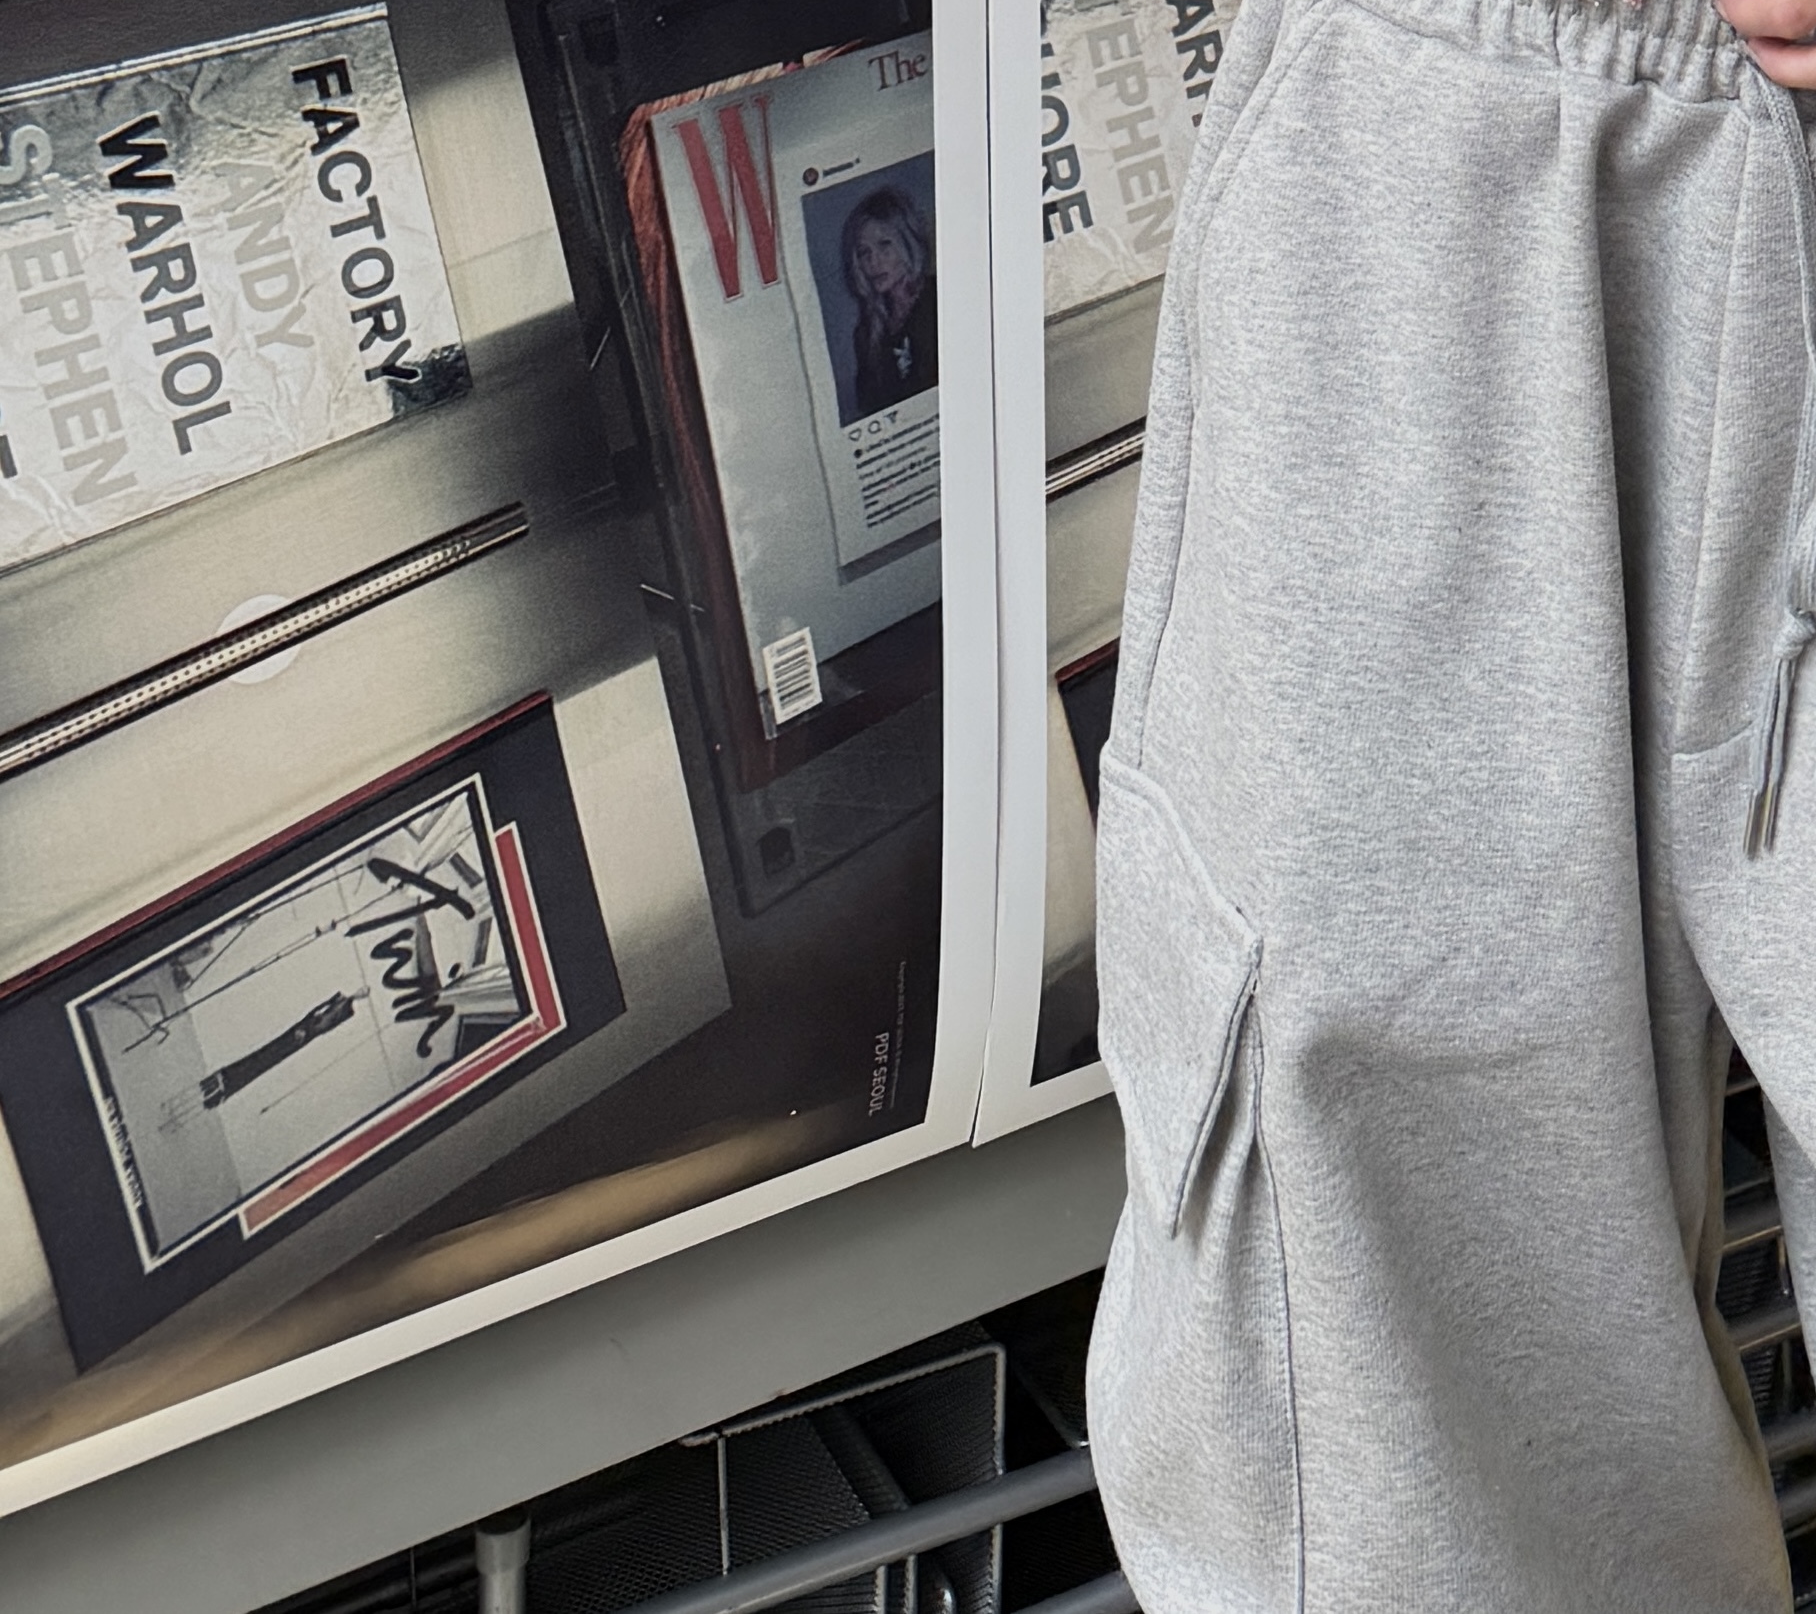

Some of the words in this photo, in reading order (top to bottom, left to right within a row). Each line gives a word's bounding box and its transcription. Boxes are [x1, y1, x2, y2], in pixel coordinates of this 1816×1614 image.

[868, 49, 929, 92] The
[98, 109, 233, 456] WARHOL
[209, 160, 316, 352] ANDY
[292, 53, 424, 385] FACTORY
[670, 92, 781, 304] W
[0, 123, 139, 507] STEPHEN
[344, 855, 478, 1060] Twin
[874, 1032, 890, 1063] PDF
[868, 1065, 888, 1117] SEOUL
